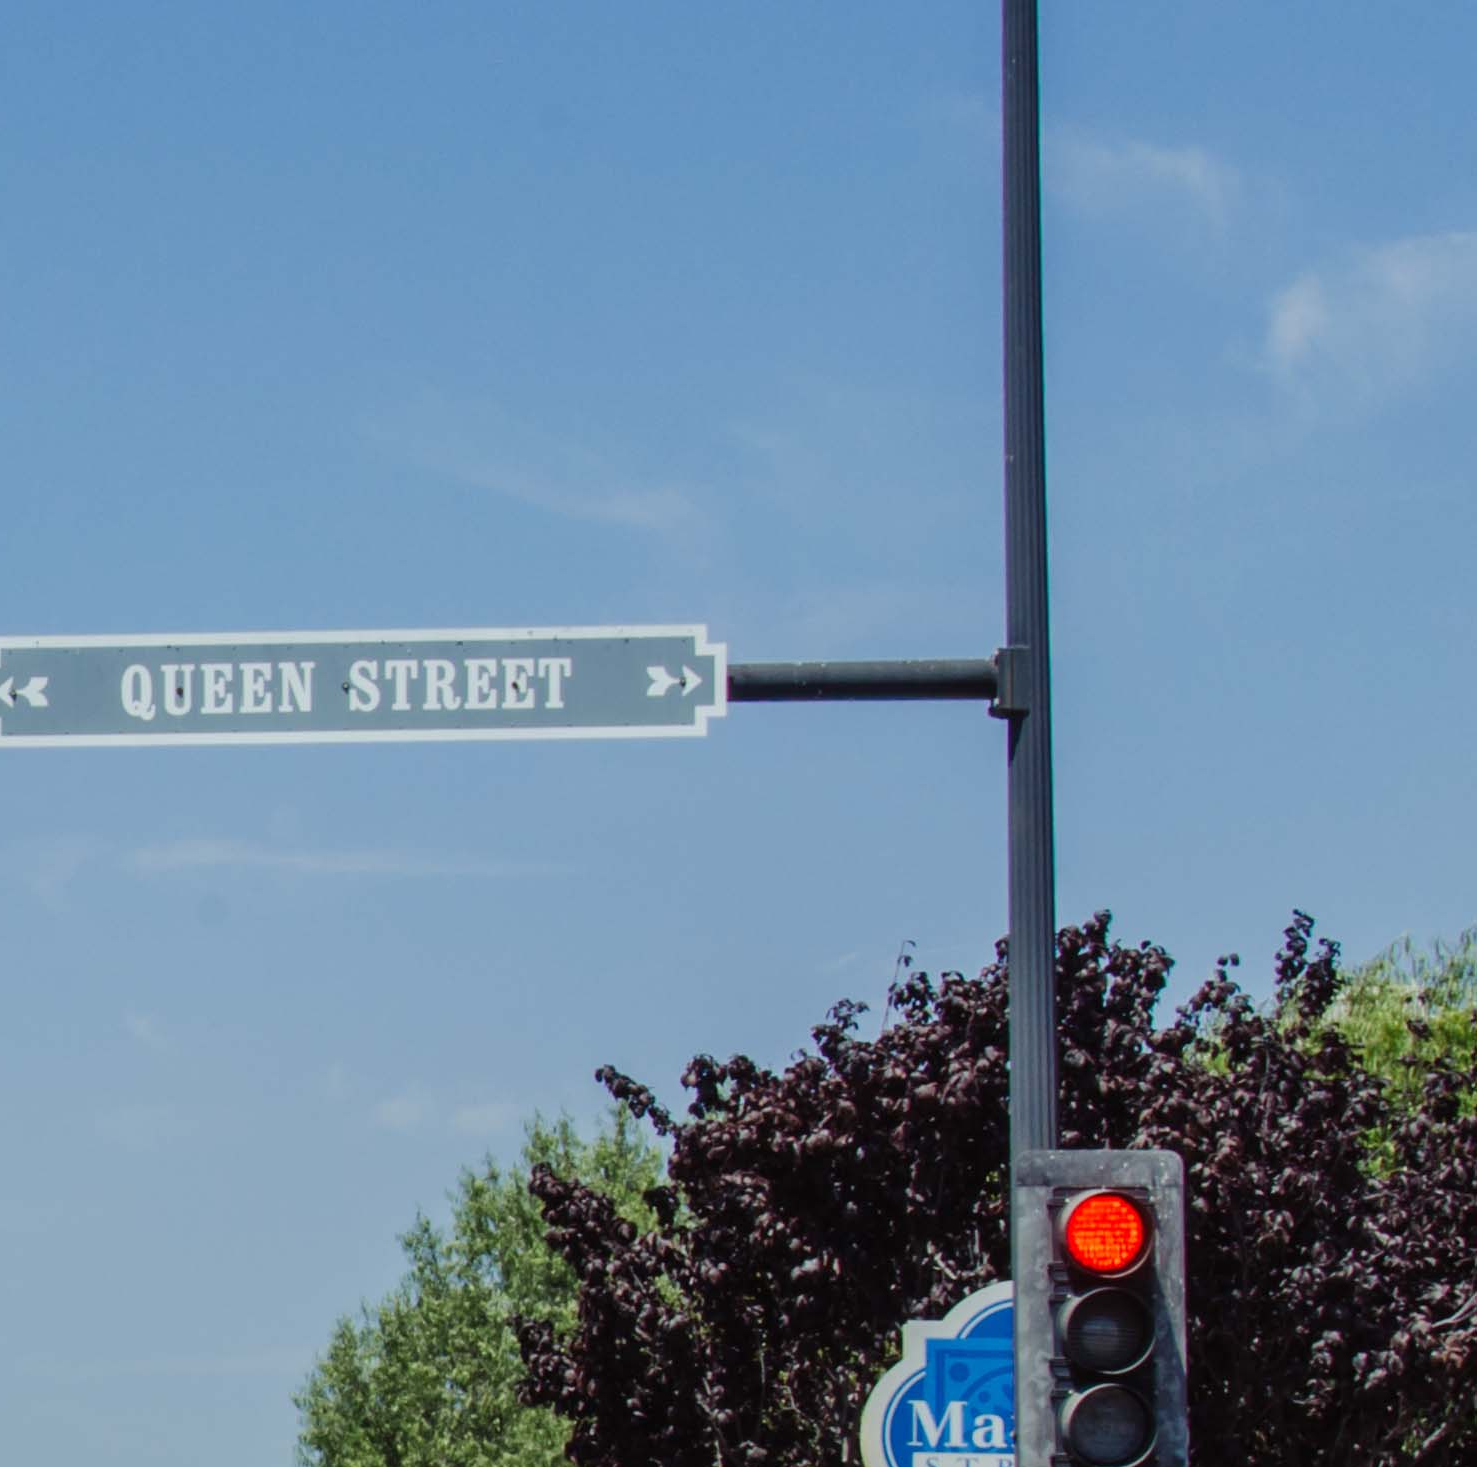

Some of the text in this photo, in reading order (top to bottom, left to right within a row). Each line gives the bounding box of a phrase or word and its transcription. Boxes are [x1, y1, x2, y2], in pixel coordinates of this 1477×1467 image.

[119, 657, 573, 721] QUEEN STREET
[907, 1399, 1014, 1450] Ma
